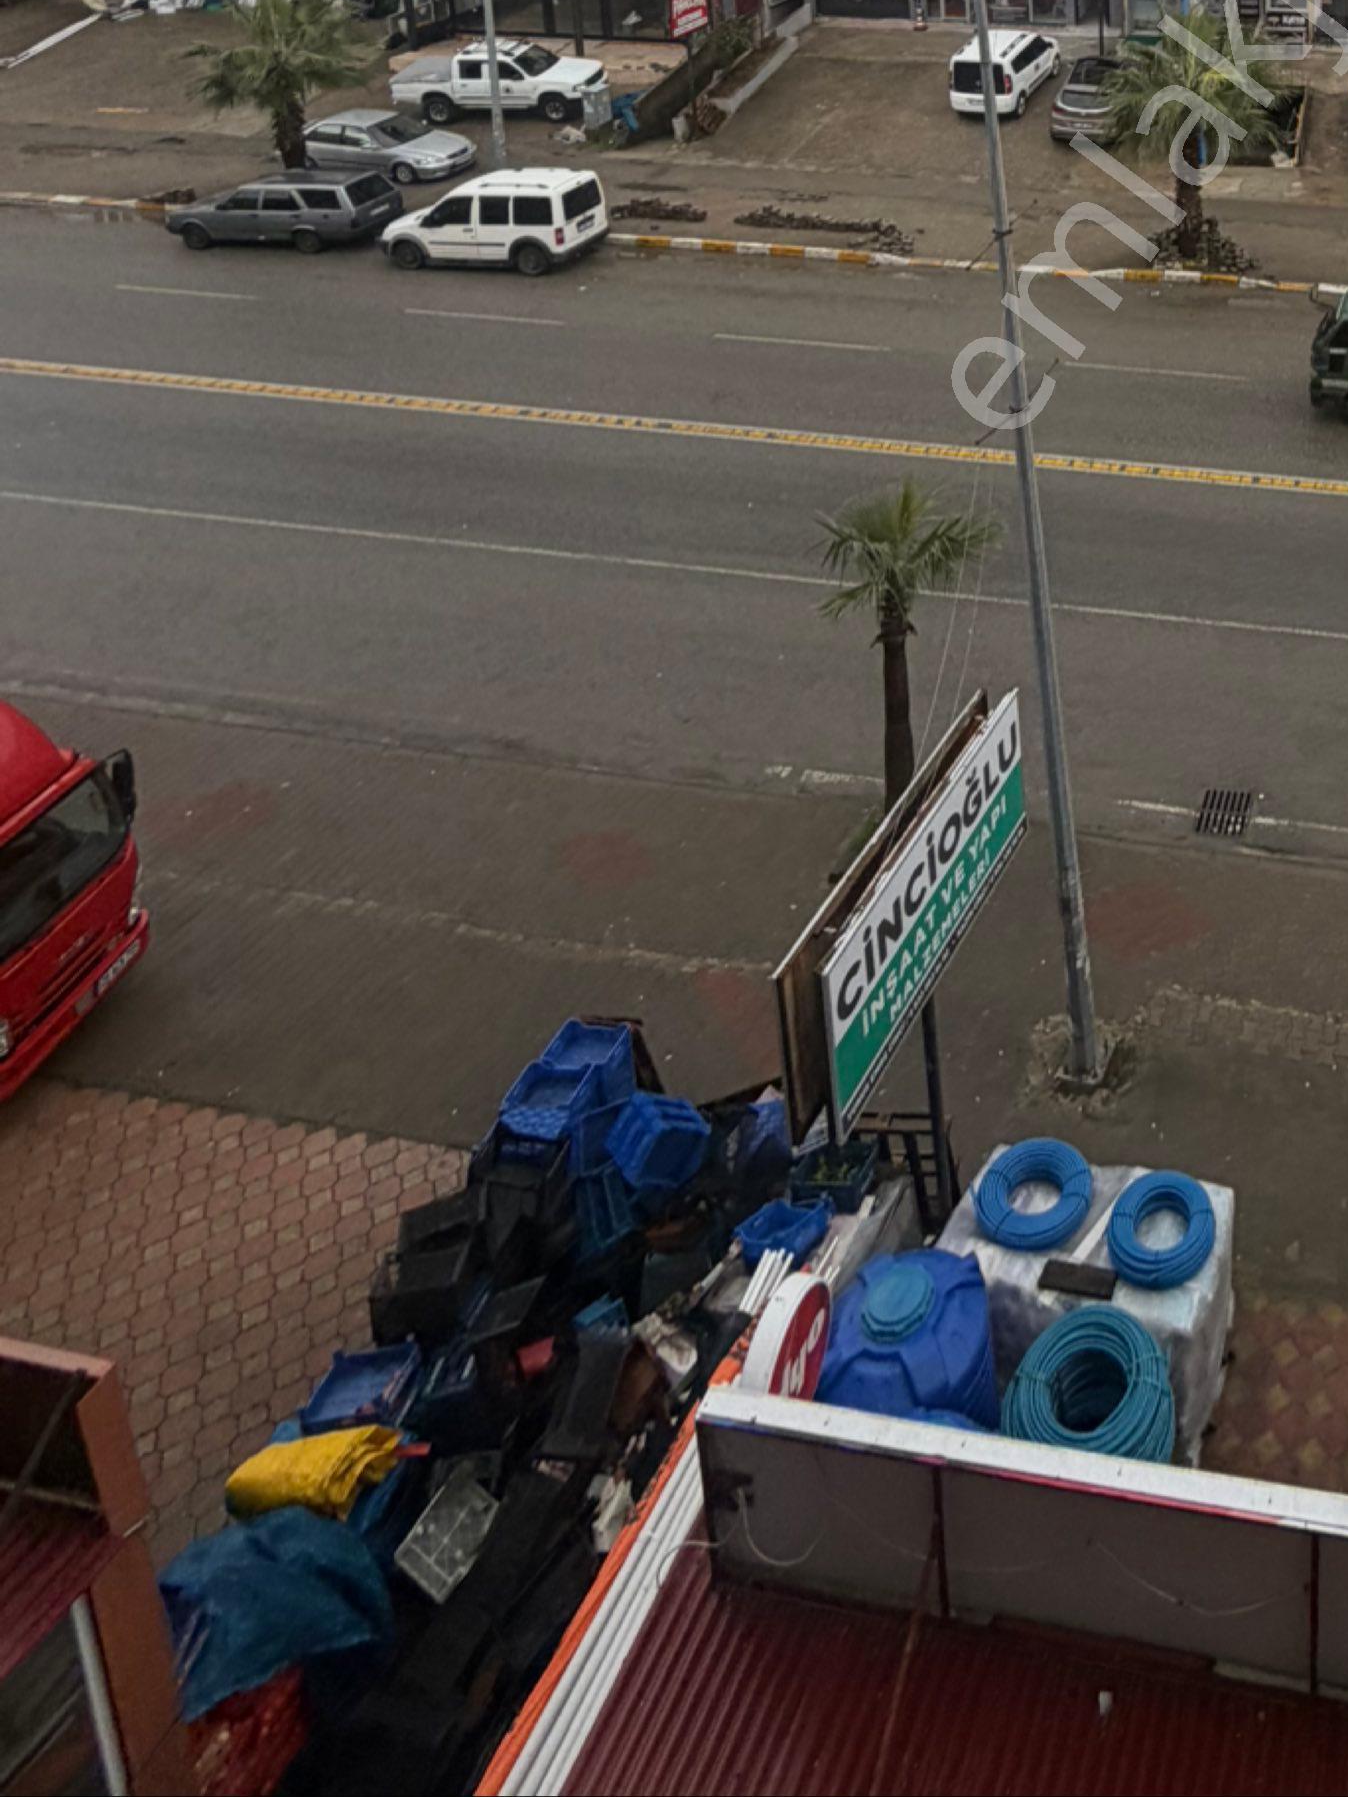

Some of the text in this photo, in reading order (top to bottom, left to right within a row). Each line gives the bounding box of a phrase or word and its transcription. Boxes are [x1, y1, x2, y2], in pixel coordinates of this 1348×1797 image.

[837, 720, 1017, 1021] CİNCİOĞLU
[861, 793, 1008, 1038] İNŞAAT VE YAPI
[889, 845, 991, 1025] MALZEMELERİ
